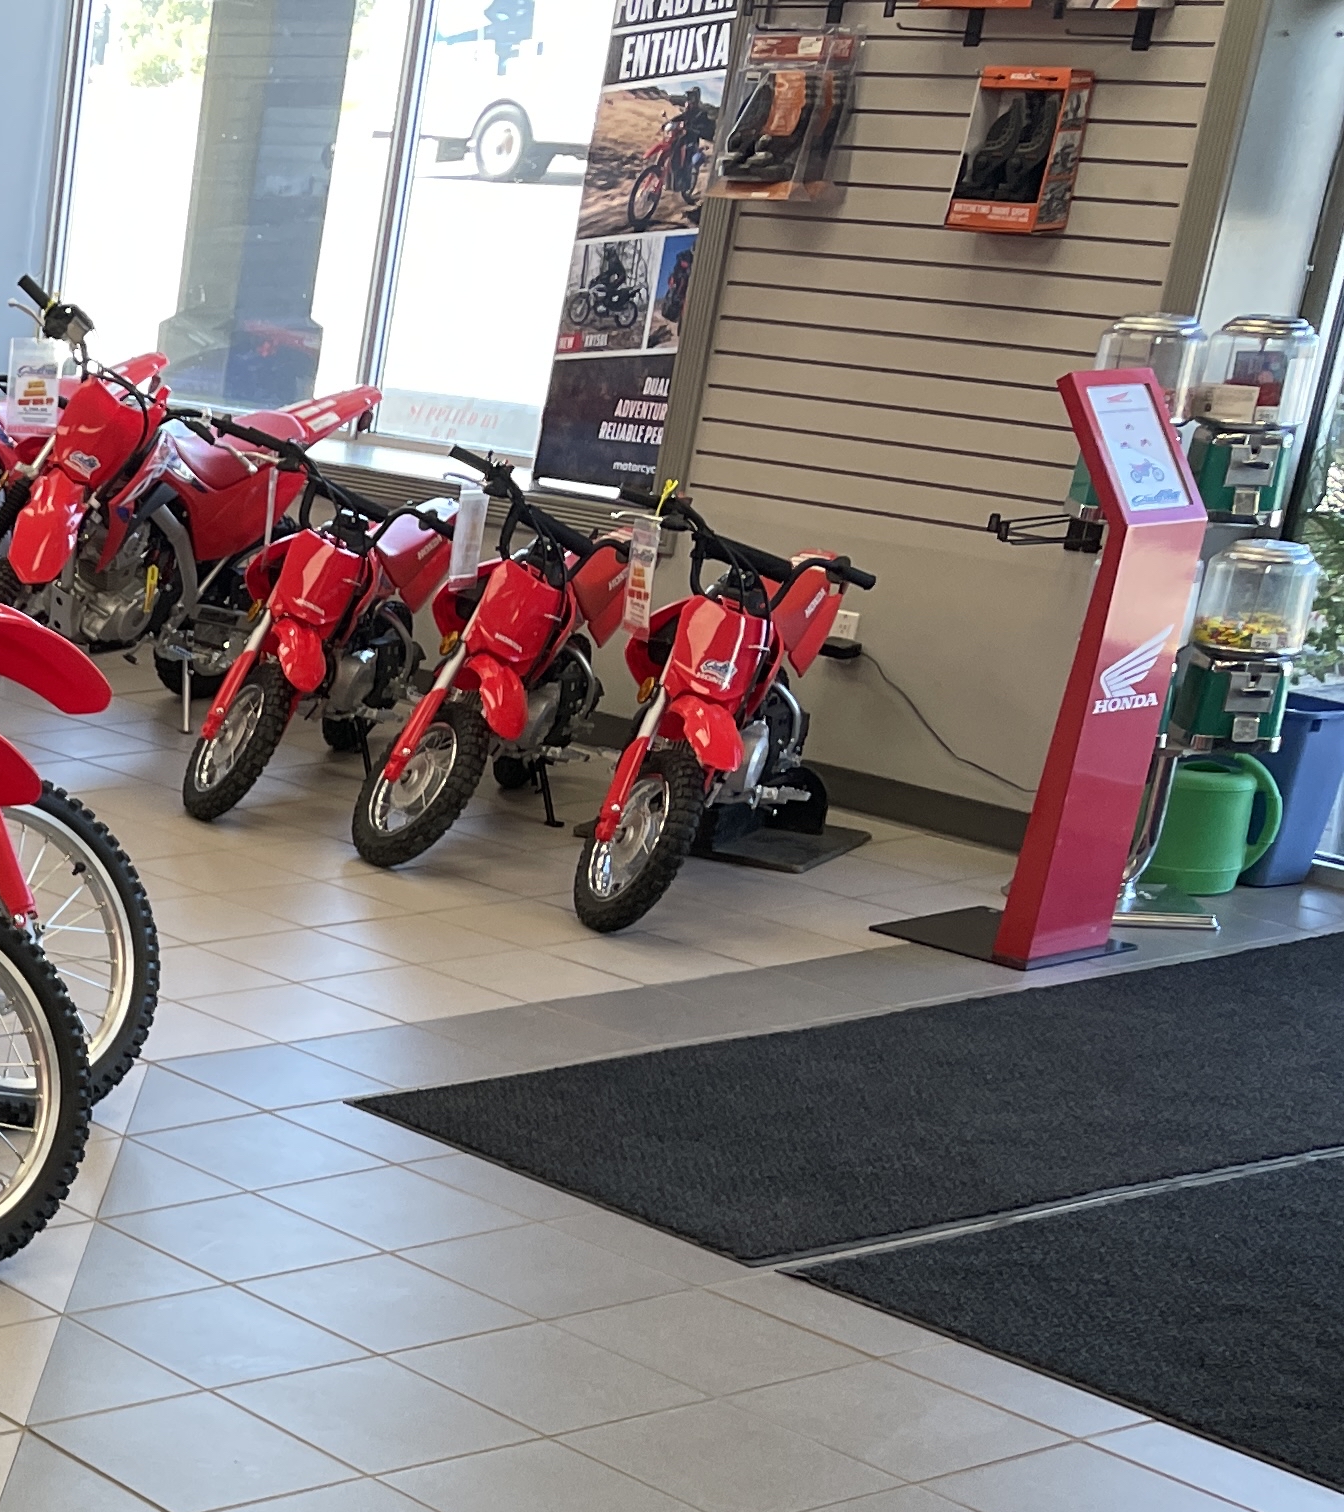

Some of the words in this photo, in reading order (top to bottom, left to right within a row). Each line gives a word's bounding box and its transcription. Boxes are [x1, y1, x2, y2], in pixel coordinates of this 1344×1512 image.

[619, 22, 731, 80] ENTHUSIA
[643, 376, 670, 396] DUAL
[614, 398, 668, 420] ADVENTUR
[598, 420, 642, 443] RELIABLE
[608, 567, 629, 592] HON
[1092, 692, 1159, 715] HONDA
